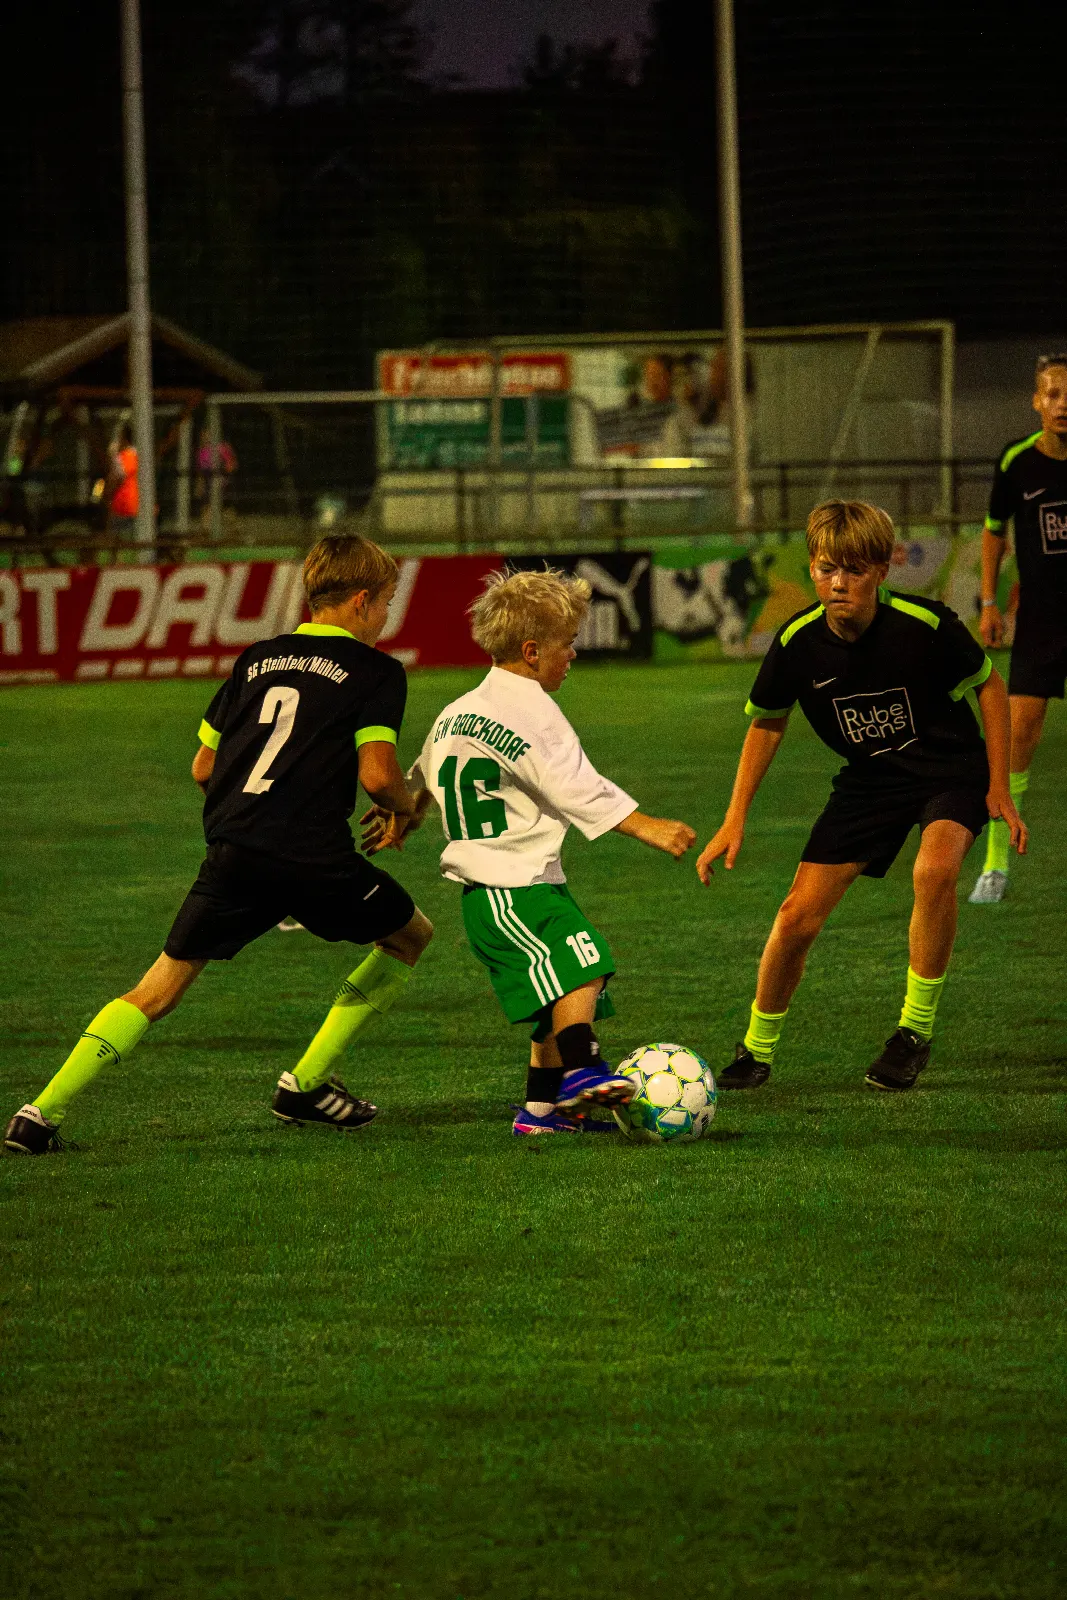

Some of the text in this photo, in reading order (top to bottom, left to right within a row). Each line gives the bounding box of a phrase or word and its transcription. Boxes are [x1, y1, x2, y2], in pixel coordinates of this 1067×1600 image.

[247, 662, 259, 682] SG
[242, 686, 300, 795] 2
[433, 713, 532, 763] GW BROCKDORF
[438, 755, 508, 840] 16
[565, 930, 600, 969] 16
